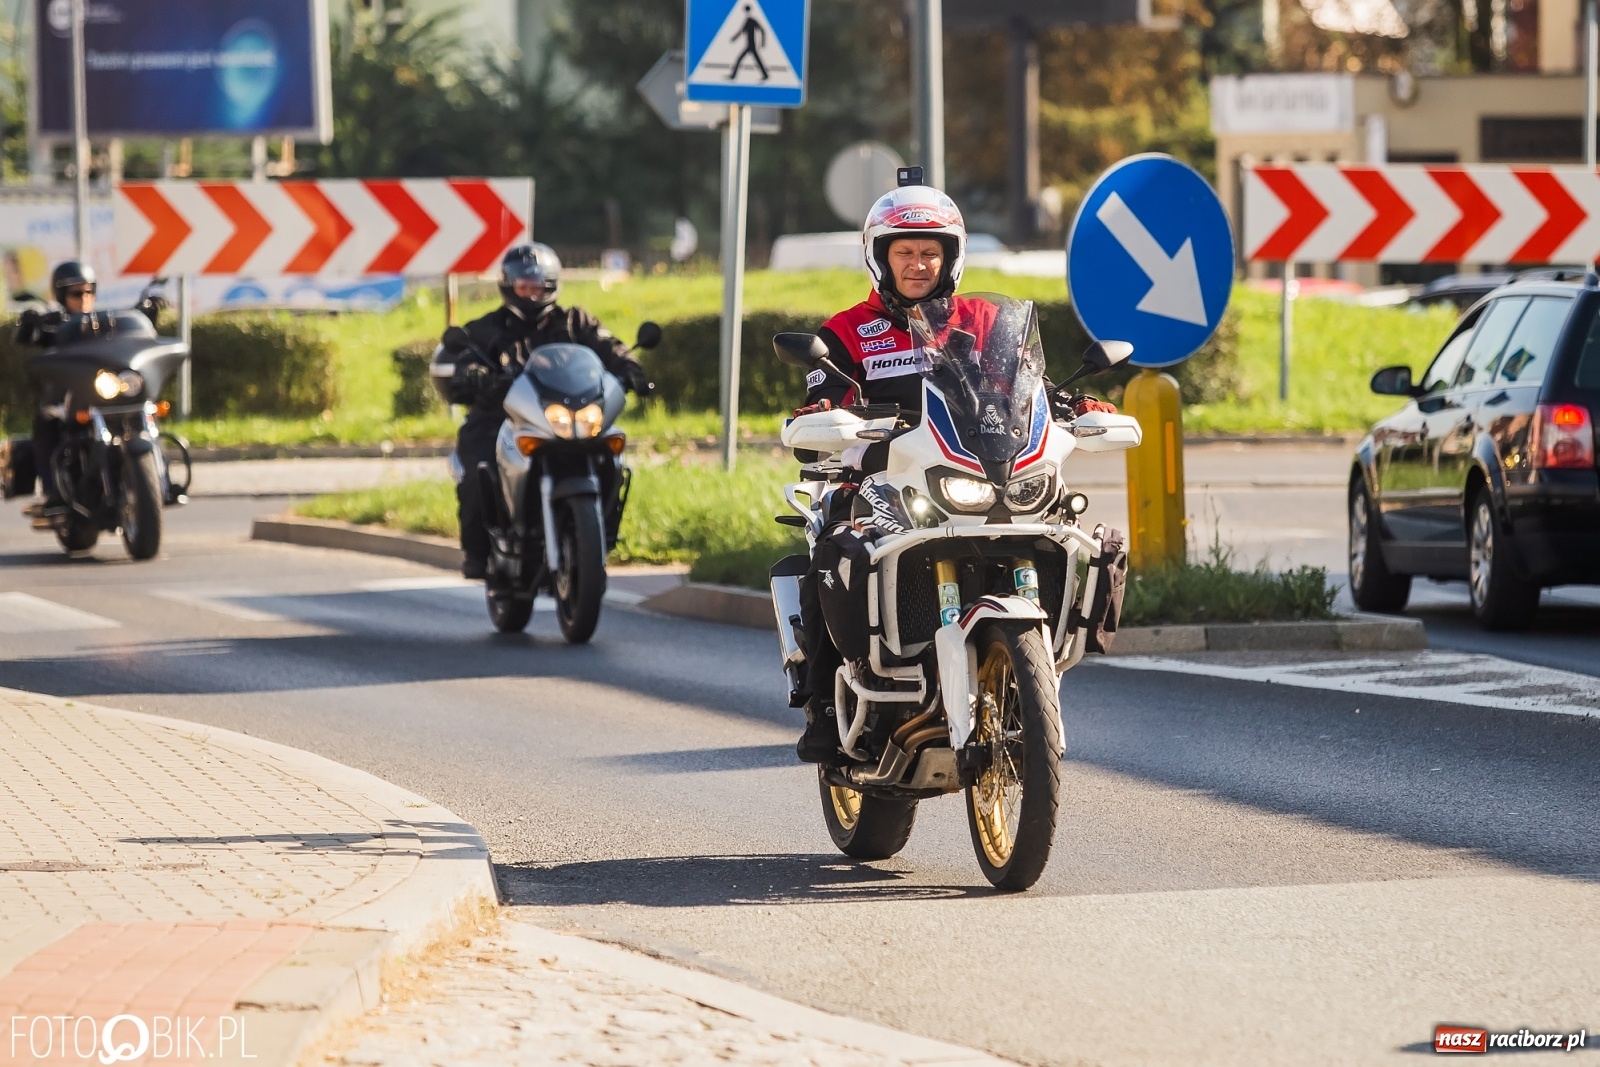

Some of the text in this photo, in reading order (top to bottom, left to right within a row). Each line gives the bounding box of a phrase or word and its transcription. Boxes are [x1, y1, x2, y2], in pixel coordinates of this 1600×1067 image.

[862, 321, 886, 335] SHOEI
[860, 337, 896, 352] HRC
[980, 424, 1007, 435] DAKAR
[859, 476, 894, 516] Africa
[855, 507, 909, 535] Twin
